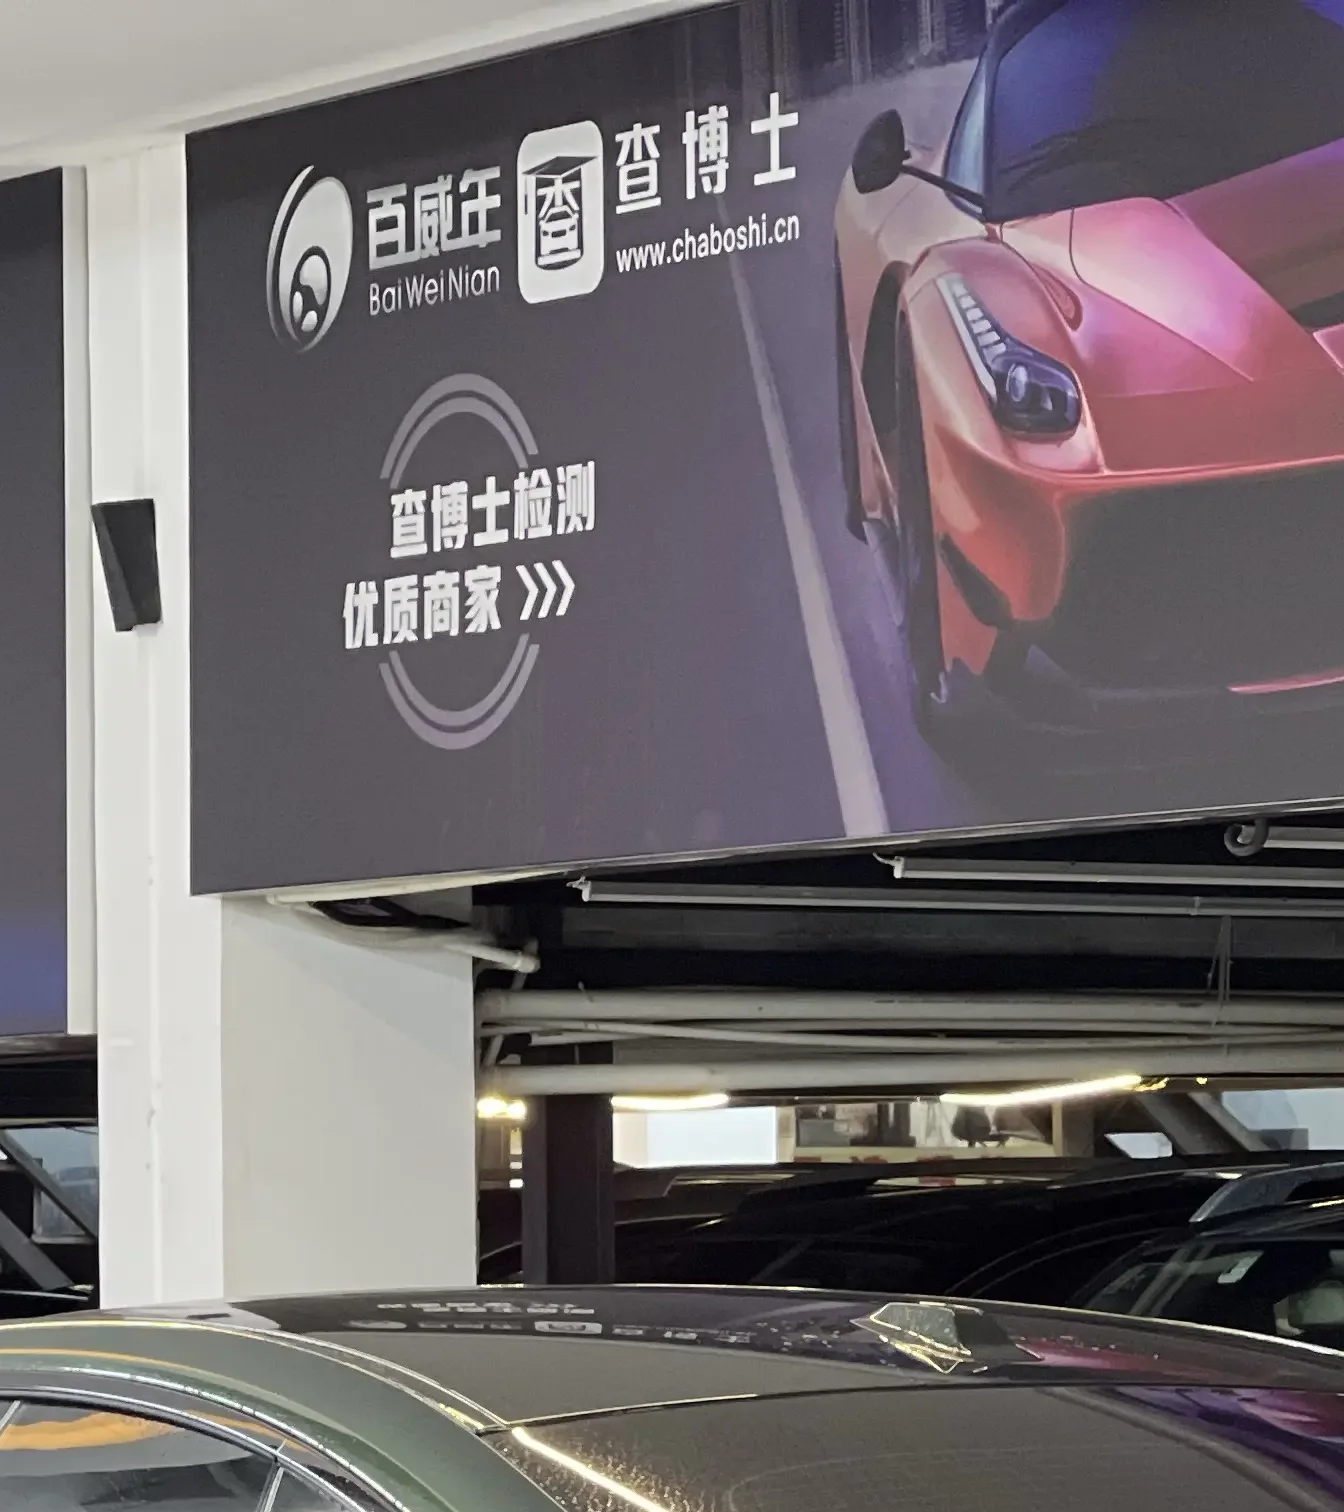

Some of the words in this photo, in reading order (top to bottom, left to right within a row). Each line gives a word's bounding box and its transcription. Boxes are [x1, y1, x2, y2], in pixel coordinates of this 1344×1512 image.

[615, 91, 799, 215] 查博士
[366, 166, 502, 271] 百威年
[615, 212, 800, 274] www.chaboshi.cn
[389, 460, 596, 558] 查博士检测
[342, 564, 503, 650] 优质商家
